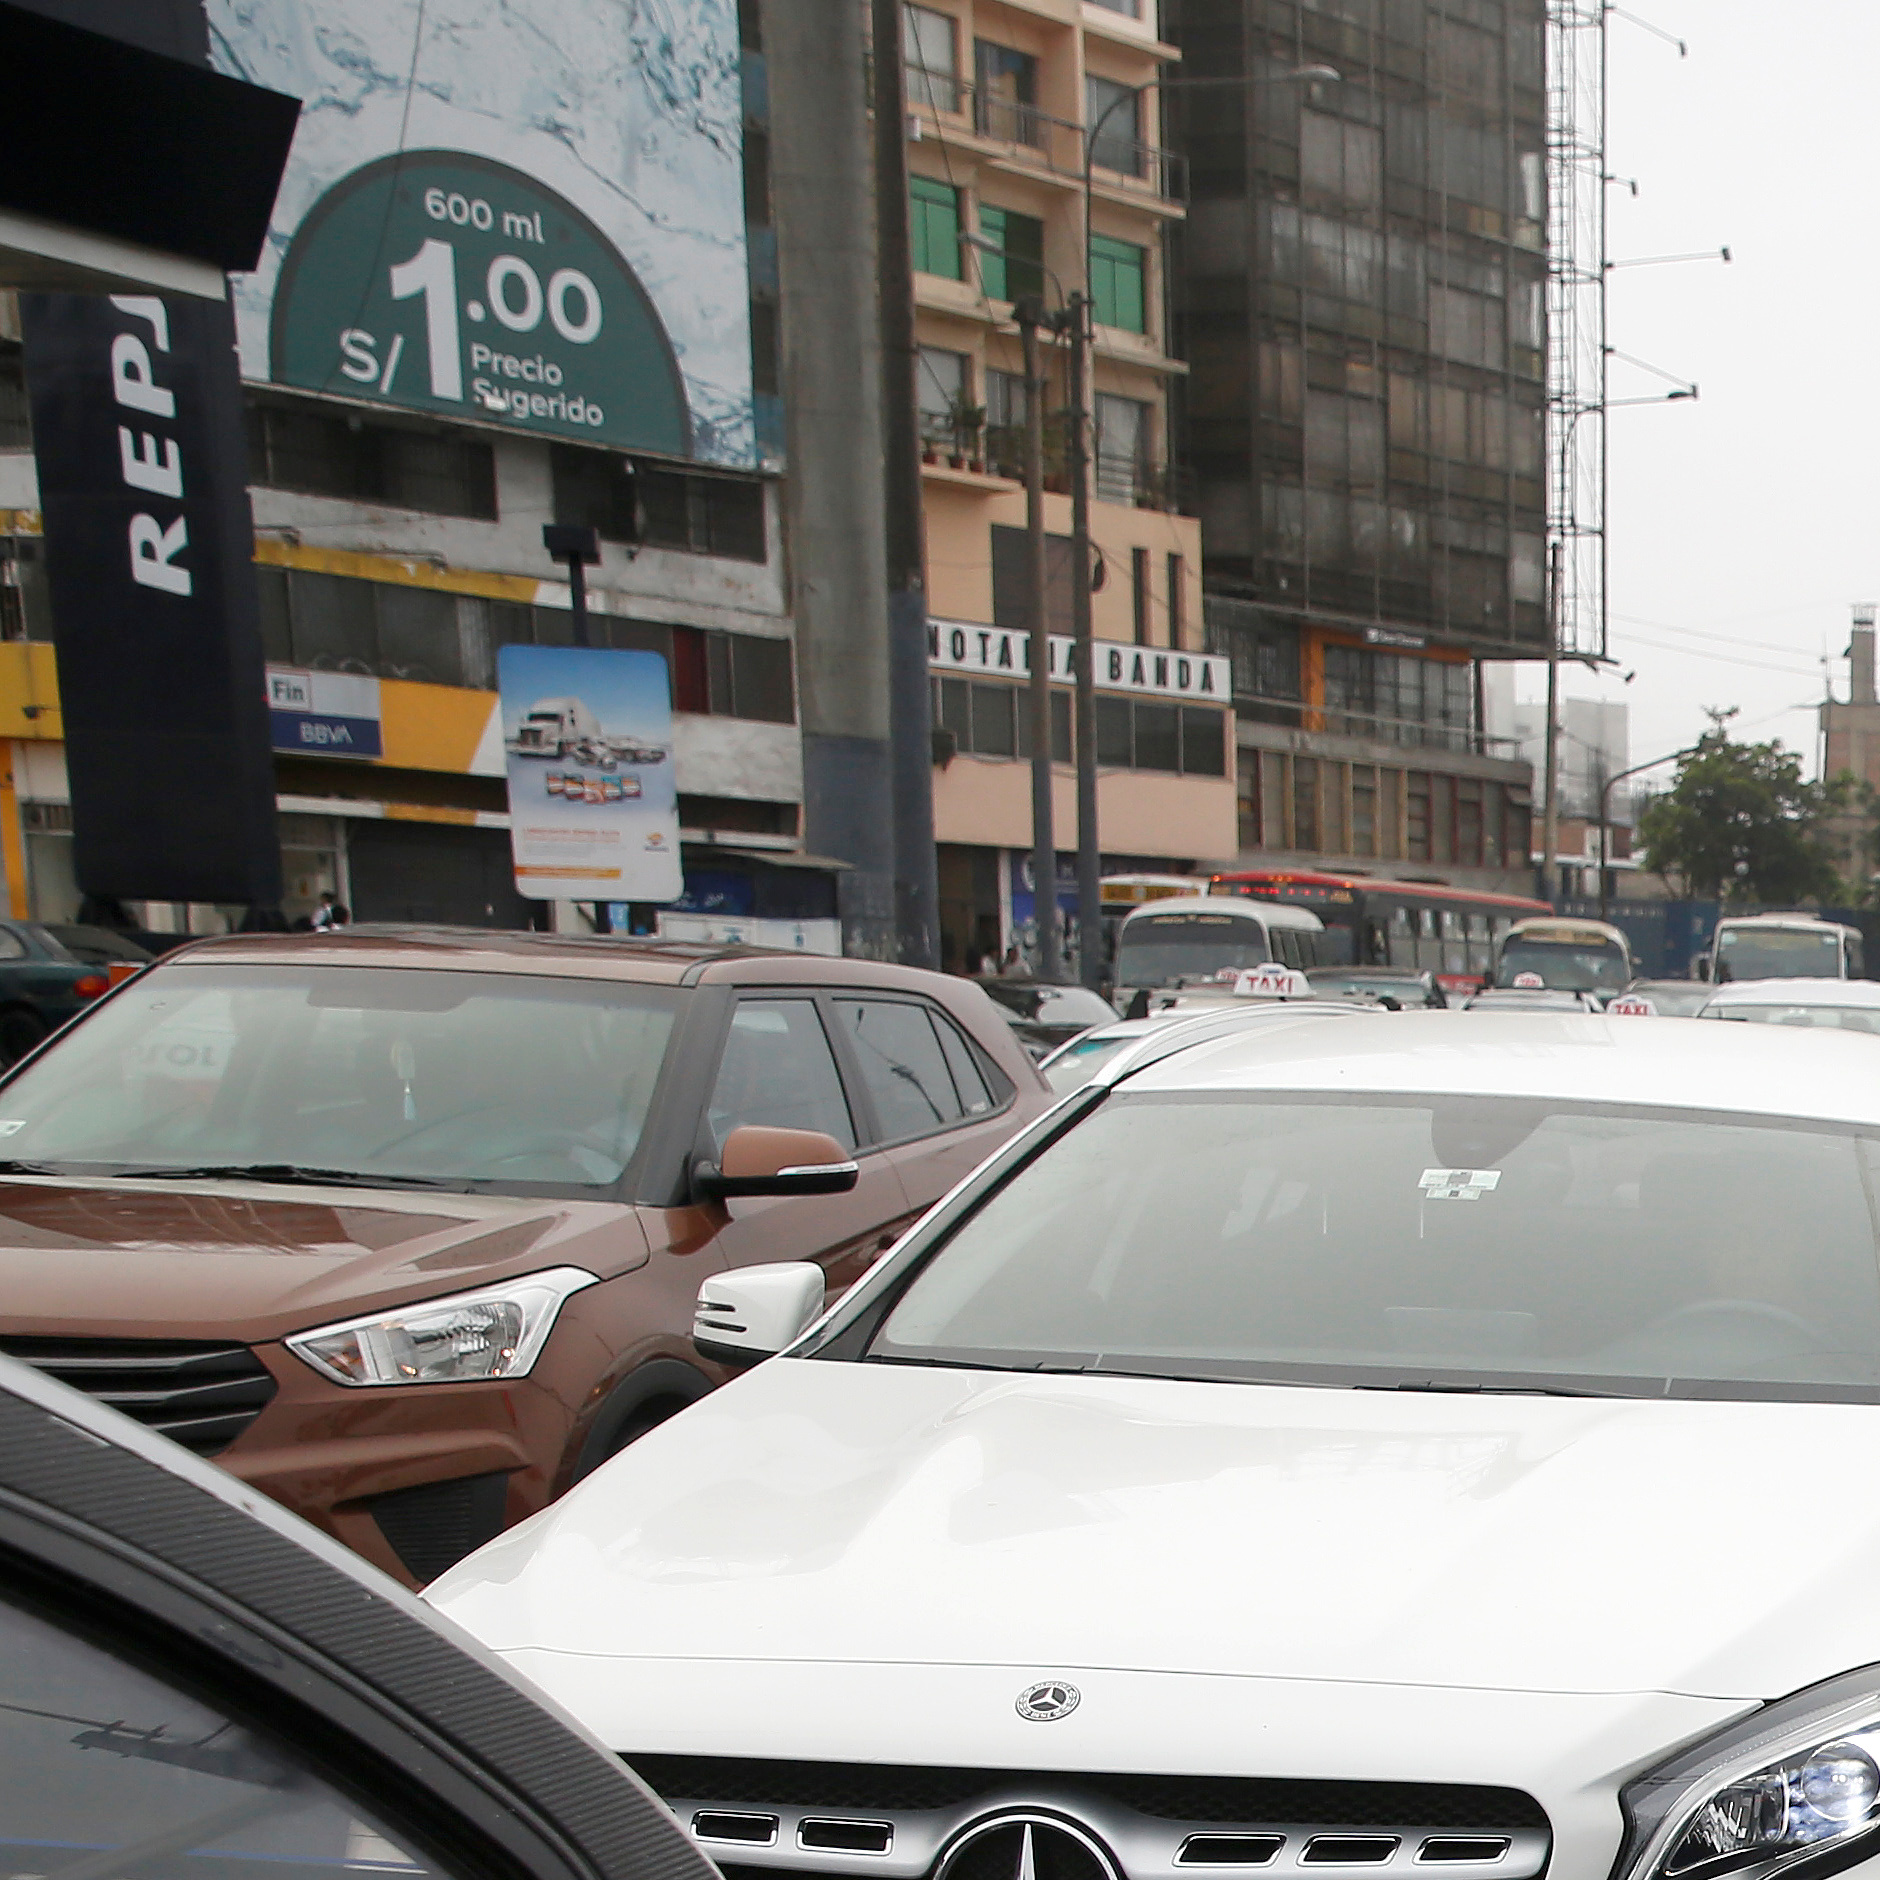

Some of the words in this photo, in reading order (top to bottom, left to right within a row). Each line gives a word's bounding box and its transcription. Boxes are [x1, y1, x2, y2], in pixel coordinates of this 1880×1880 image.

[424, 187, 494, 232] 600
[502, 210, 545, 245] ml
[389, 237, 603, 402] 1.00
[470, 342, 564, 387] Precio
[471, 377, 605, 428] Sugerido
[1109, 649, 1214, 694] BANDA
[300, 720, 354, 746] BBVA
[1246, 975, 1295, 995] TAXI
